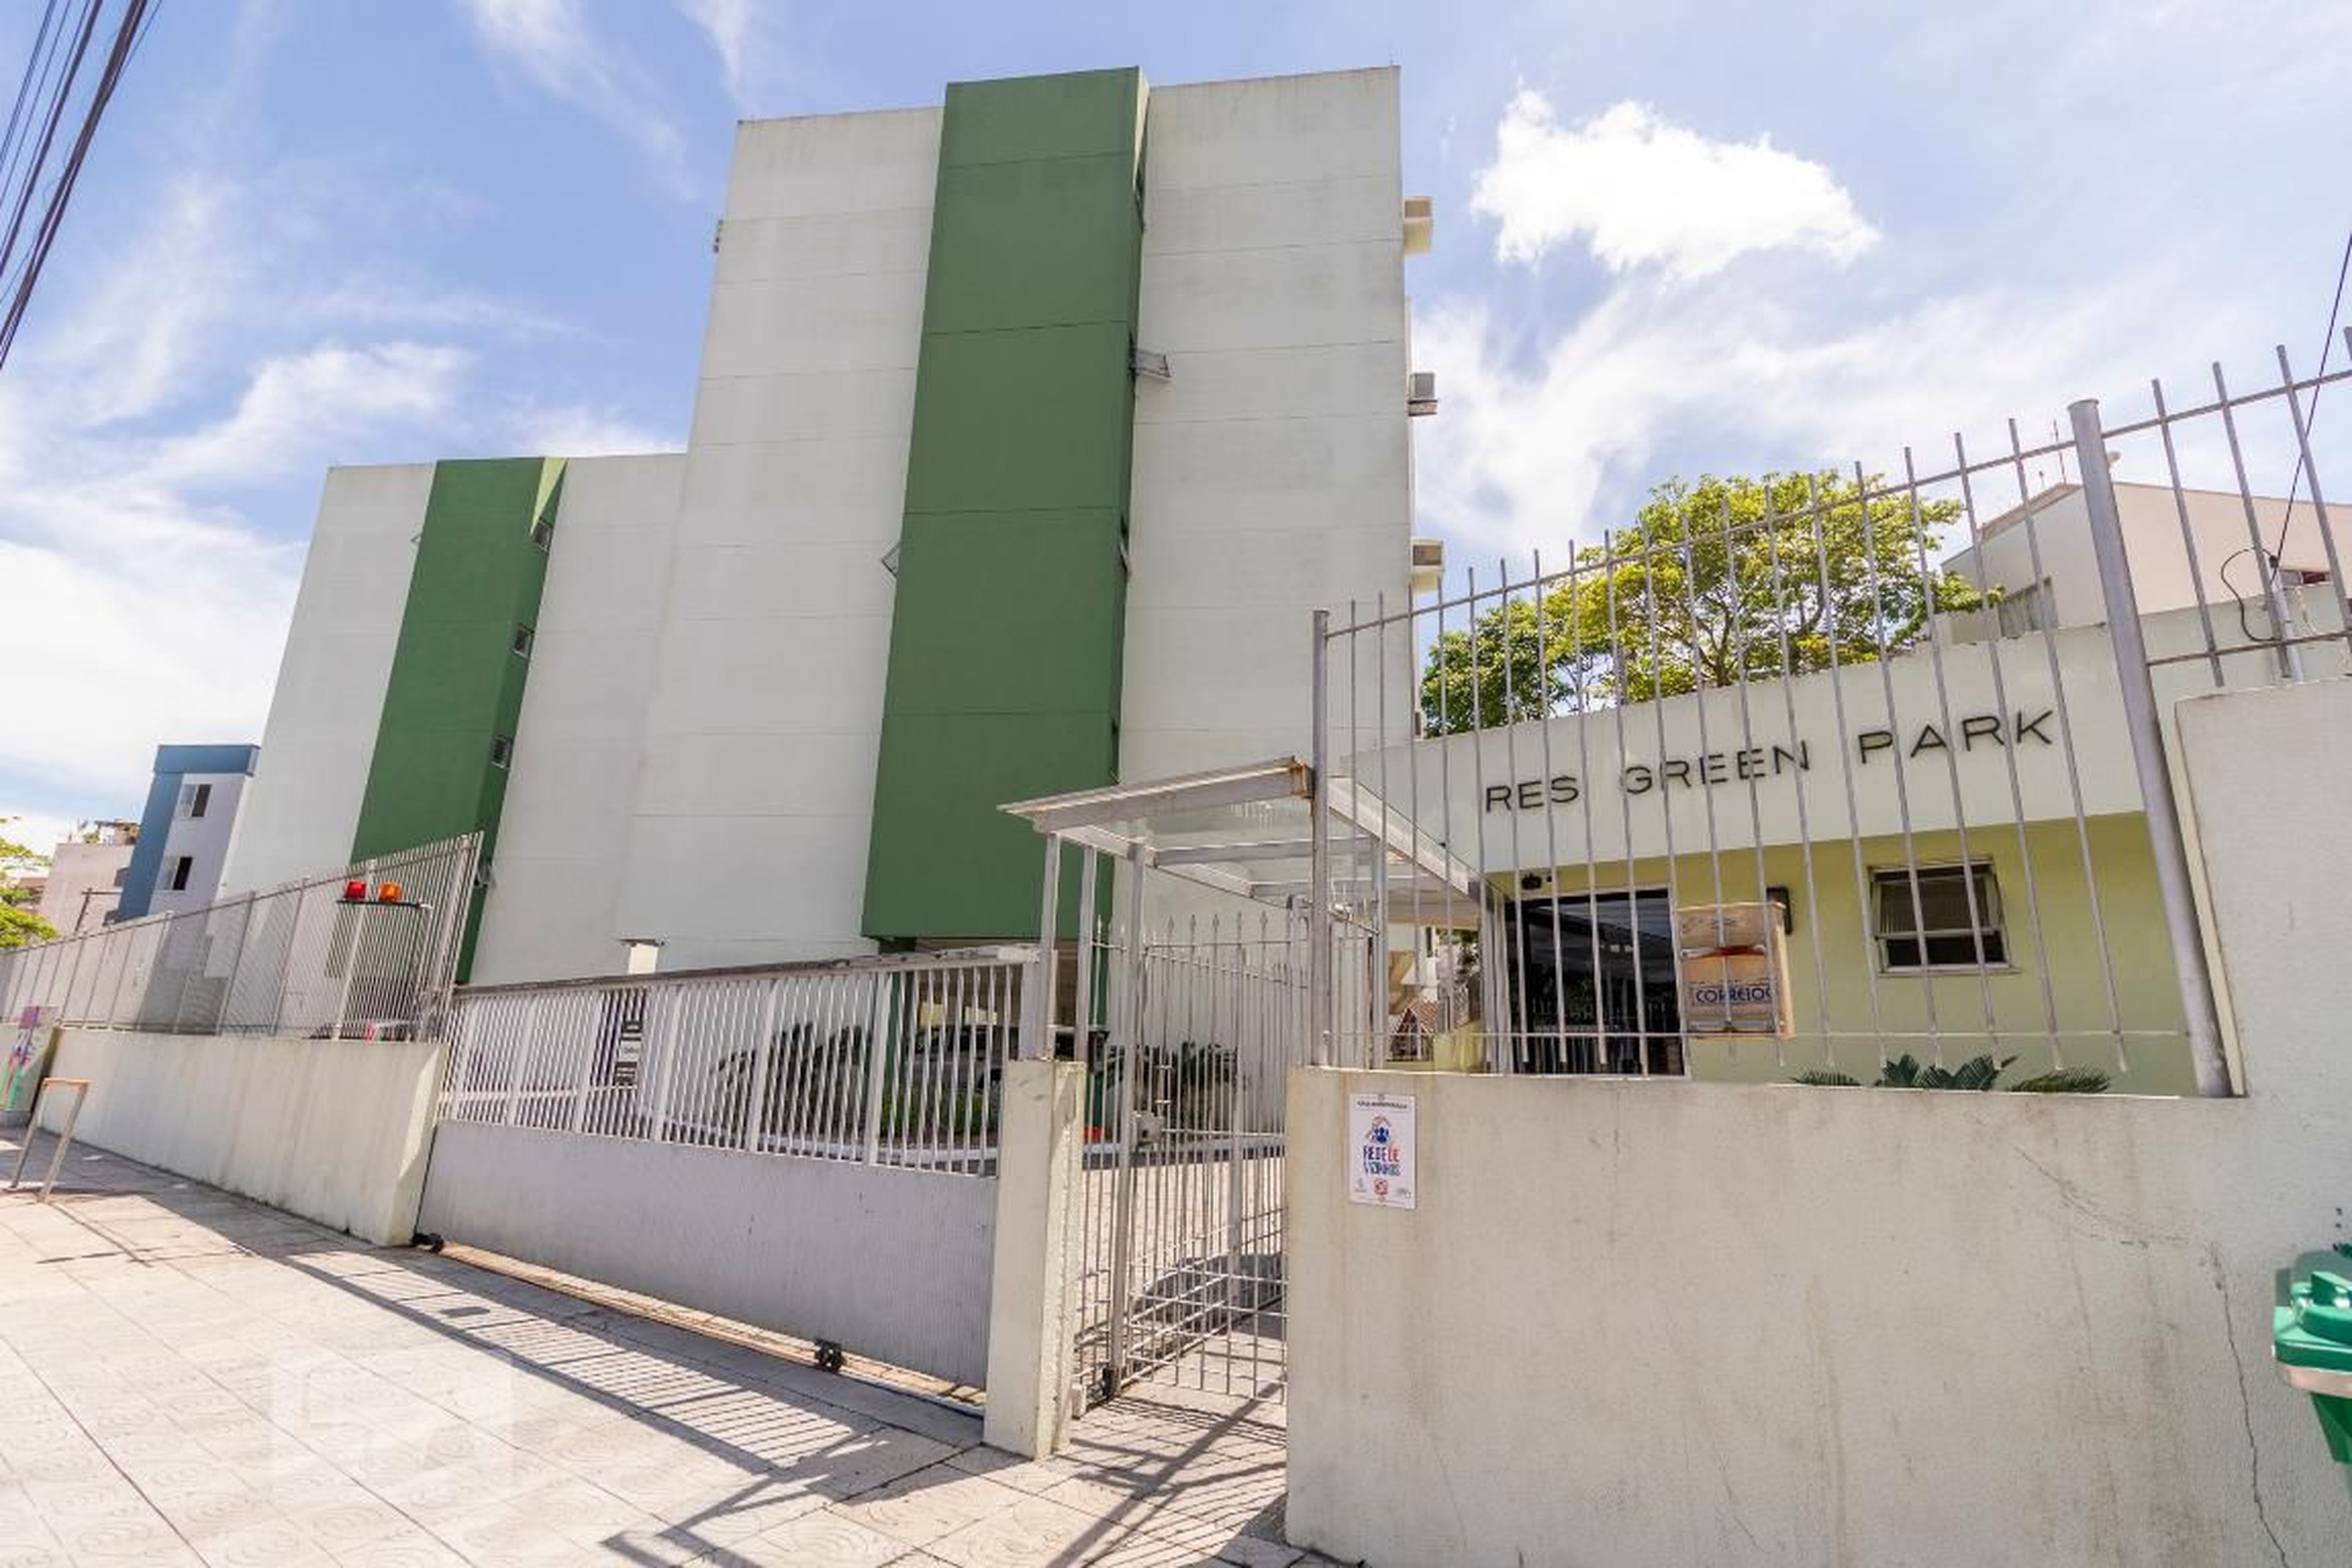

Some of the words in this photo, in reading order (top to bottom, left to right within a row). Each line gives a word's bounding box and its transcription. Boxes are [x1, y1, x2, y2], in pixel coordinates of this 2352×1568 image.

[1485, 775, 1580, 813] RES
[1621, 741, 1810, 794] GREEN
[1858, 710, 2052, 764] PARK
